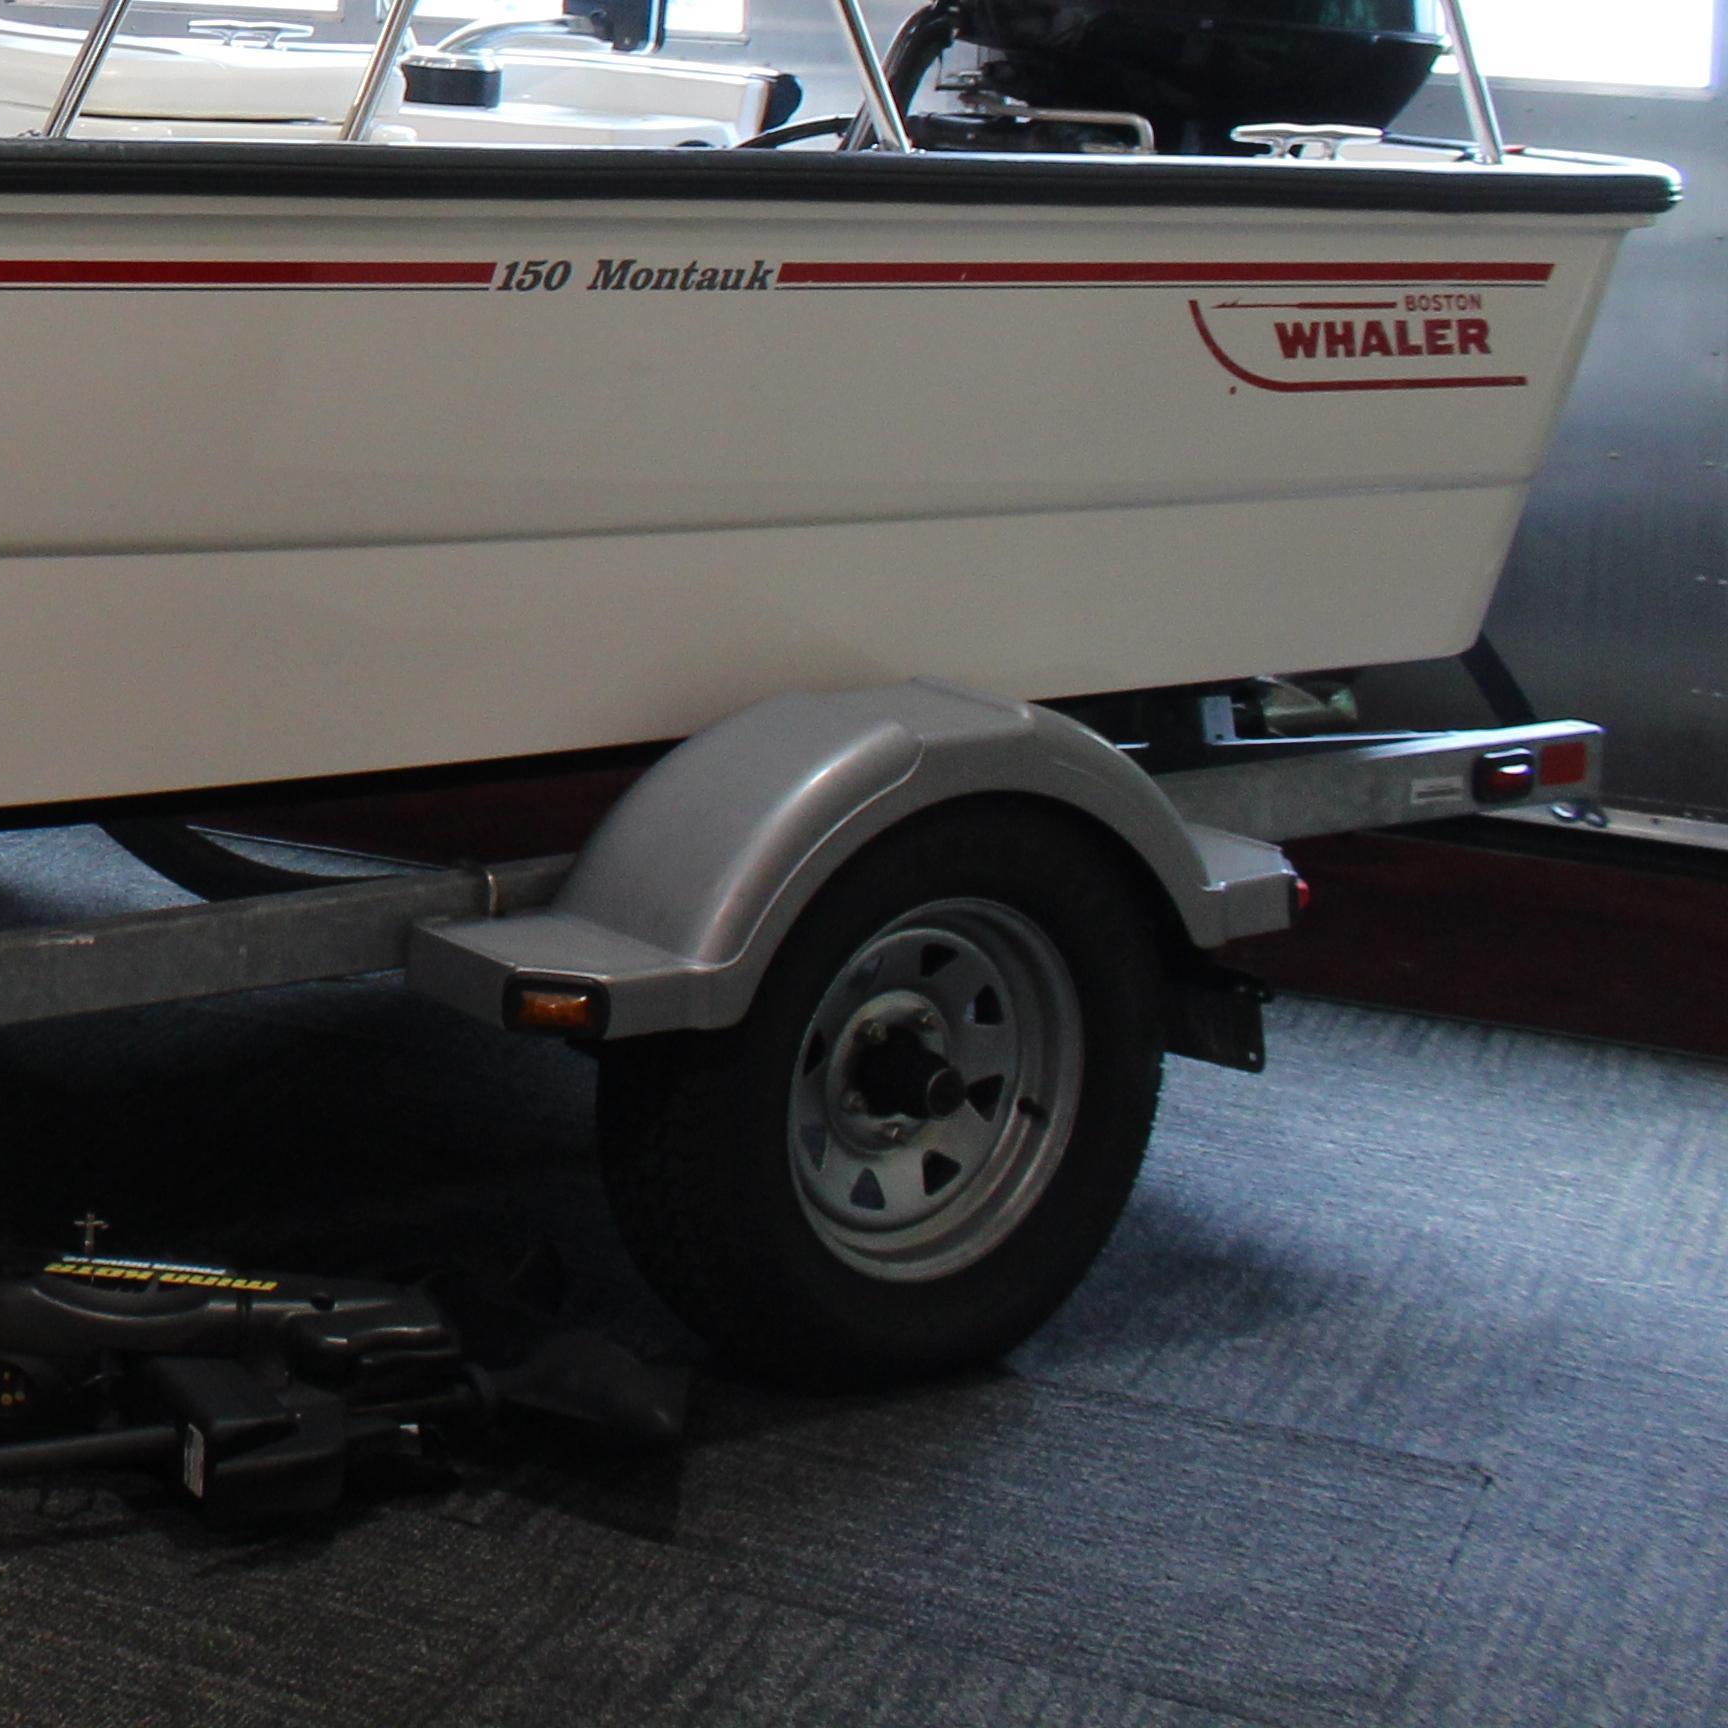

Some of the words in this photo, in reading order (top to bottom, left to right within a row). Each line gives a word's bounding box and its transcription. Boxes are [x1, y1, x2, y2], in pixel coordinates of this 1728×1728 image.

[495, 259, 572, 291] 150
[586, 258, 774, 291] Montauk
[1404, 293, 1482, 312] BOSTON
[1273, 317, 1492, 359] WHALER
